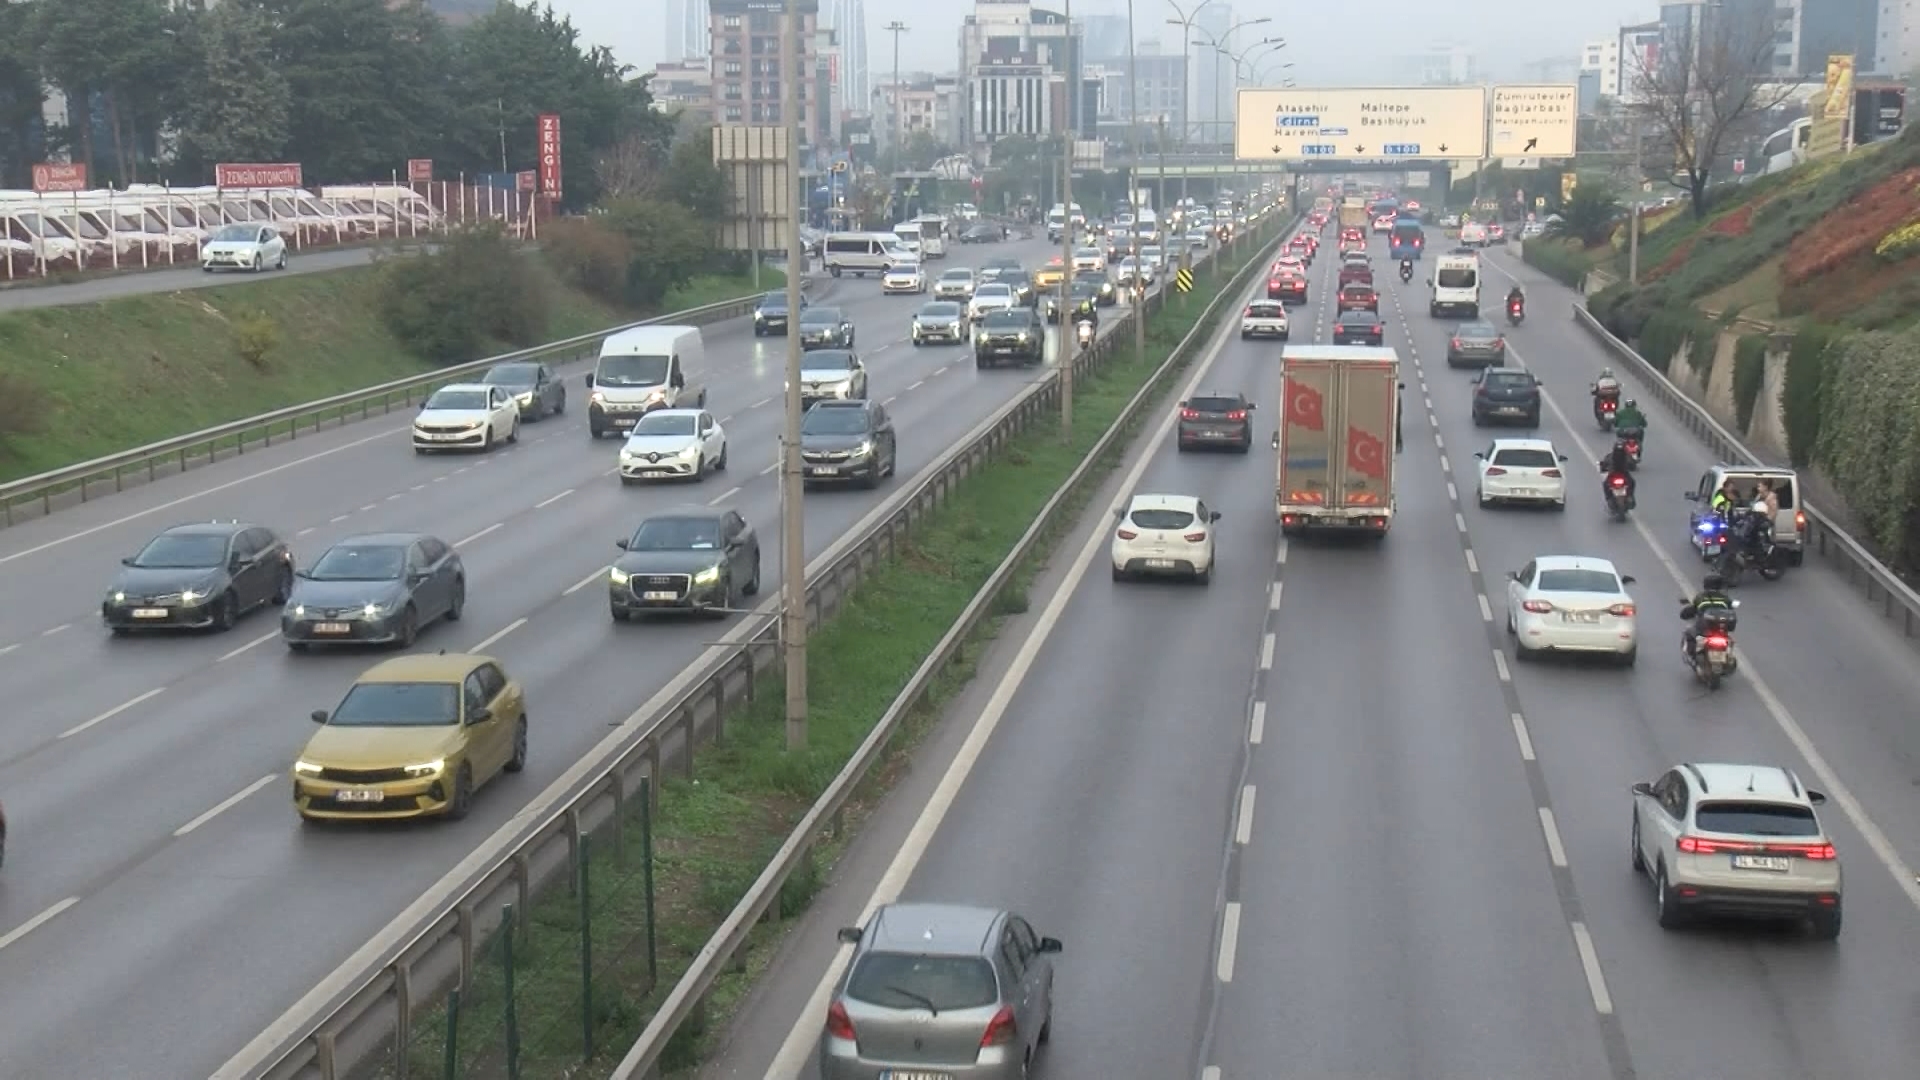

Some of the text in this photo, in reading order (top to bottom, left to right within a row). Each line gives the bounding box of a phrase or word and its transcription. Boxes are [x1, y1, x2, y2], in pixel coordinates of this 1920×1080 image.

[1361, 103, 1410, 113] Maltepe
[1278, 116, 1318, 126] Edirne
[1275, 128, 1318, 136] Harem
